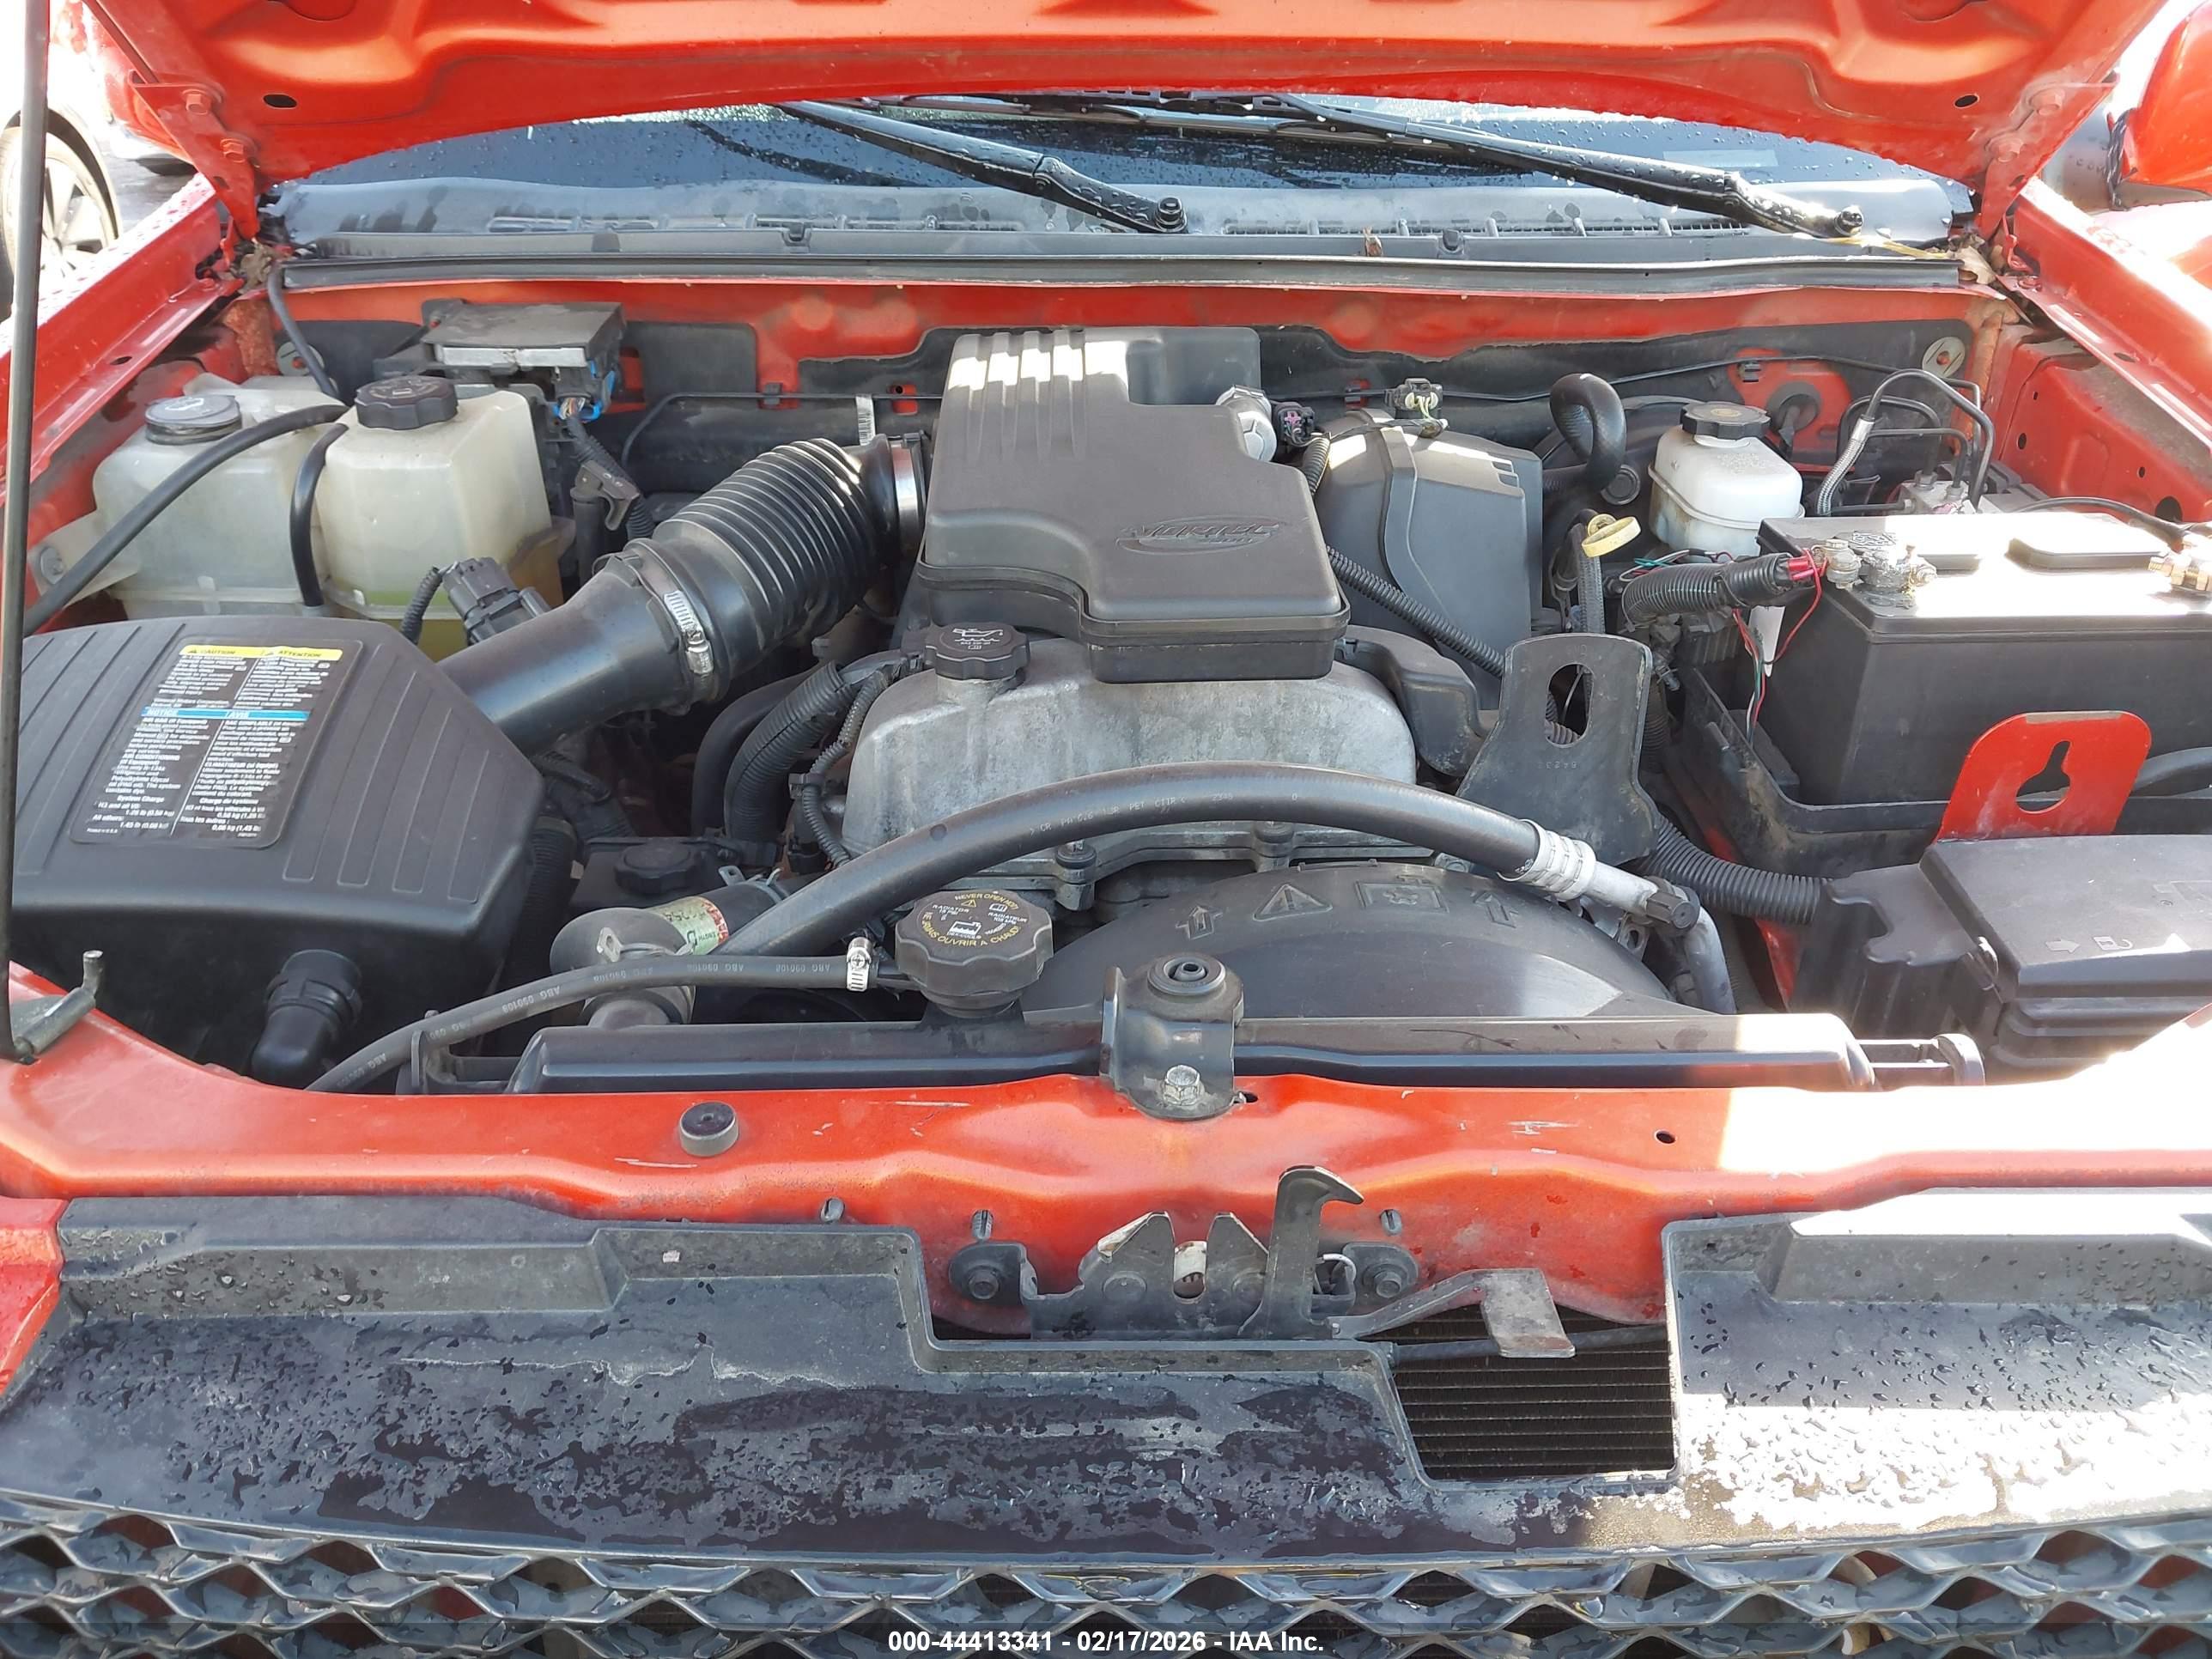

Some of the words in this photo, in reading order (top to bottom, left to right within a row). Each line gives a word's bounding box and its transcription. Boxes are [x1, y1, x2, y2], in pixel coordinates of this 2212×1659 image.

[938, 935, 977, 946] OUVRIR
[724, 963, 744, 972] ABG
[811, 963, 831, 972] ABG
[539, 985, 560, 1000] ABG
[368, 1052, 387, 1069] ABG
